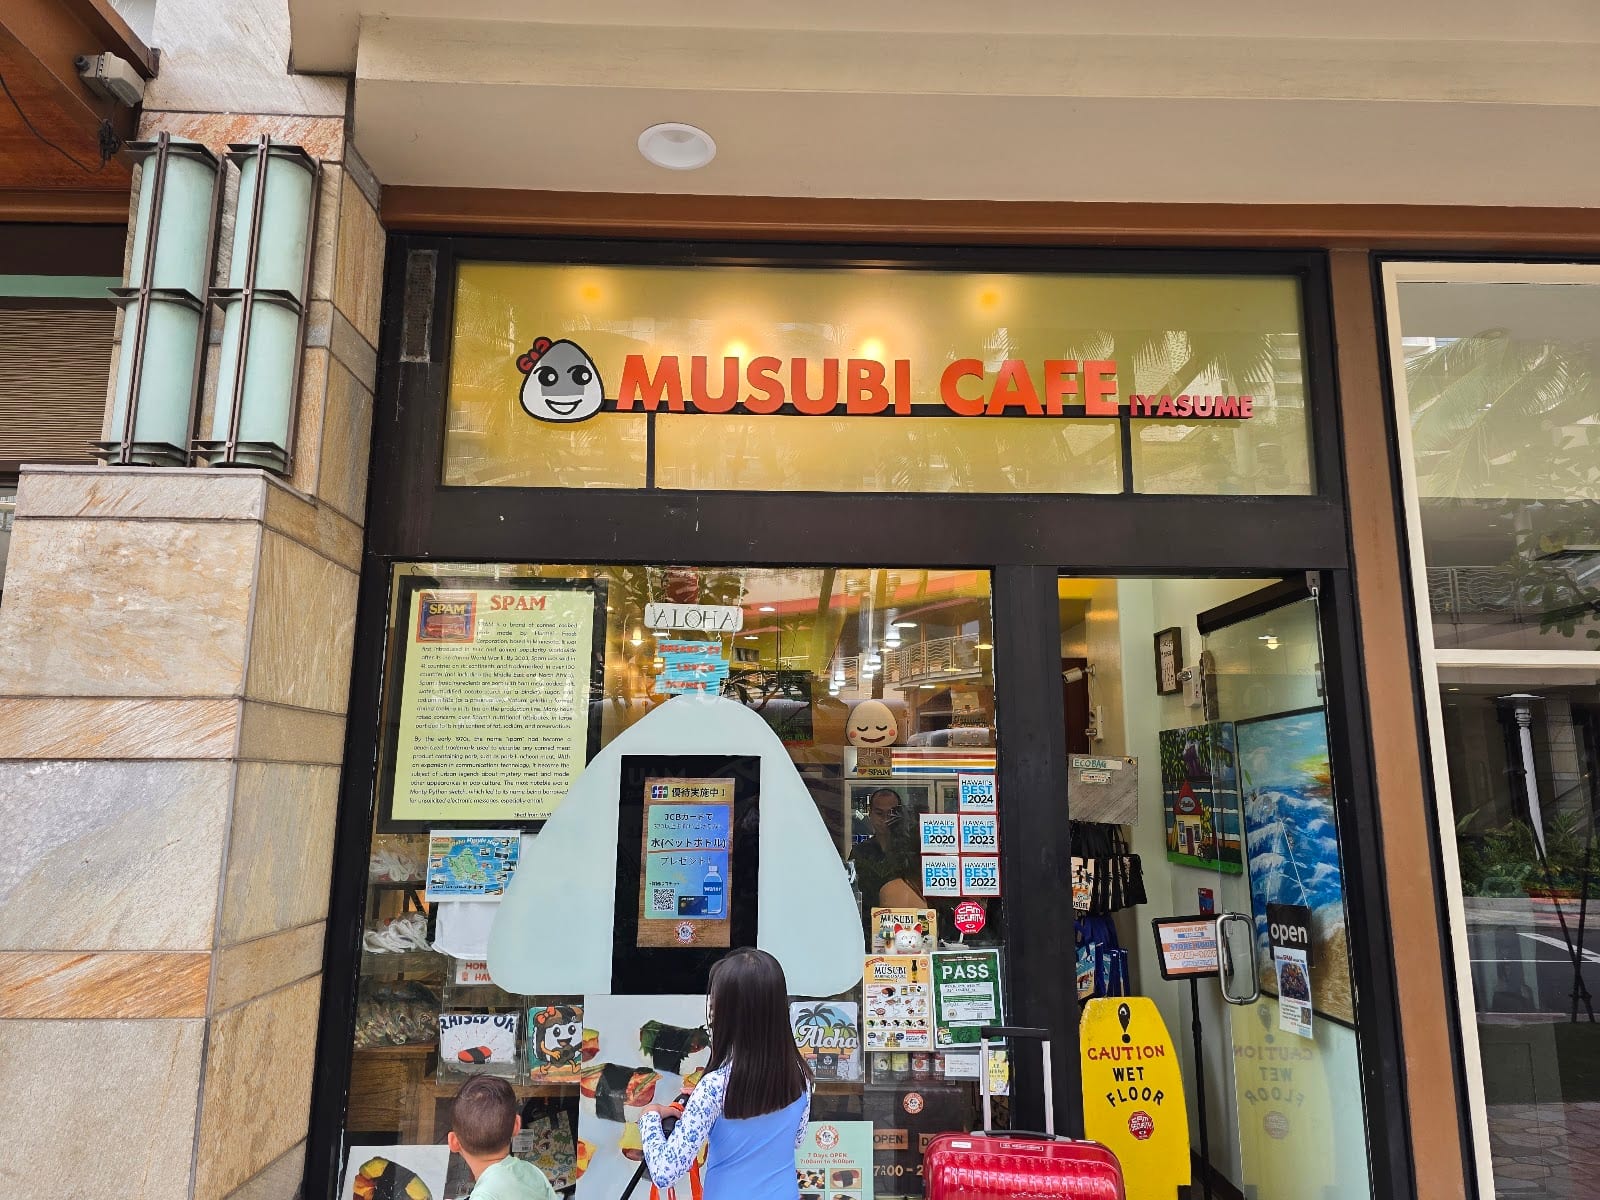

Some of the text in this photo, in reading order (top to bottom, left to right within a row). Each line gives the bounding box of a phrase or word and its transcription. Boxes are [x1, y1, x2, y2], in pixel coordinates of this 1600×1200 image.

[616, 354, 1254, 418] MUSUBI CAFE IYASUME
[490, 594, 548, 611] SPAM
[429, 602, 466, 616] SPAM
[654, 608, 737, 630] ALOHA
[868, 768, 891, 776] SPAM
[962, 786, 992, 794] BEST
[968, 794, 994, 804] 2024
[924, 826, 954, 835] BEST
[963, 826, 994, 835] BEST
[929, 835, 956, 844] 2020
[969, 835, 995, 845] 2023
[926, 868, 956, 877] BEST
[965, 868, 996, 877] BEST
[932, 877, 957, 887] 2019
[971, 877, 997, 887] 2022
[880, 914, 914, 924] MUSUBI
[957, 914, 983, 923] SECURITY
[1270, 923, 1308, 945] open
[465, 962, 487, 970] HON
[874, 966, 907, 975] MUSUBI
[942, 963, 989, 980] PASS
[795, 1024, 858, 1049] Aloha
[1087, 1045, 1165, 1061] CAUTION
[1112, 1066, 1144, 1082] WET
[1106, 1086, 1164, 1108] FLOOR
[873, 1135, 903, 1144] OPEN
